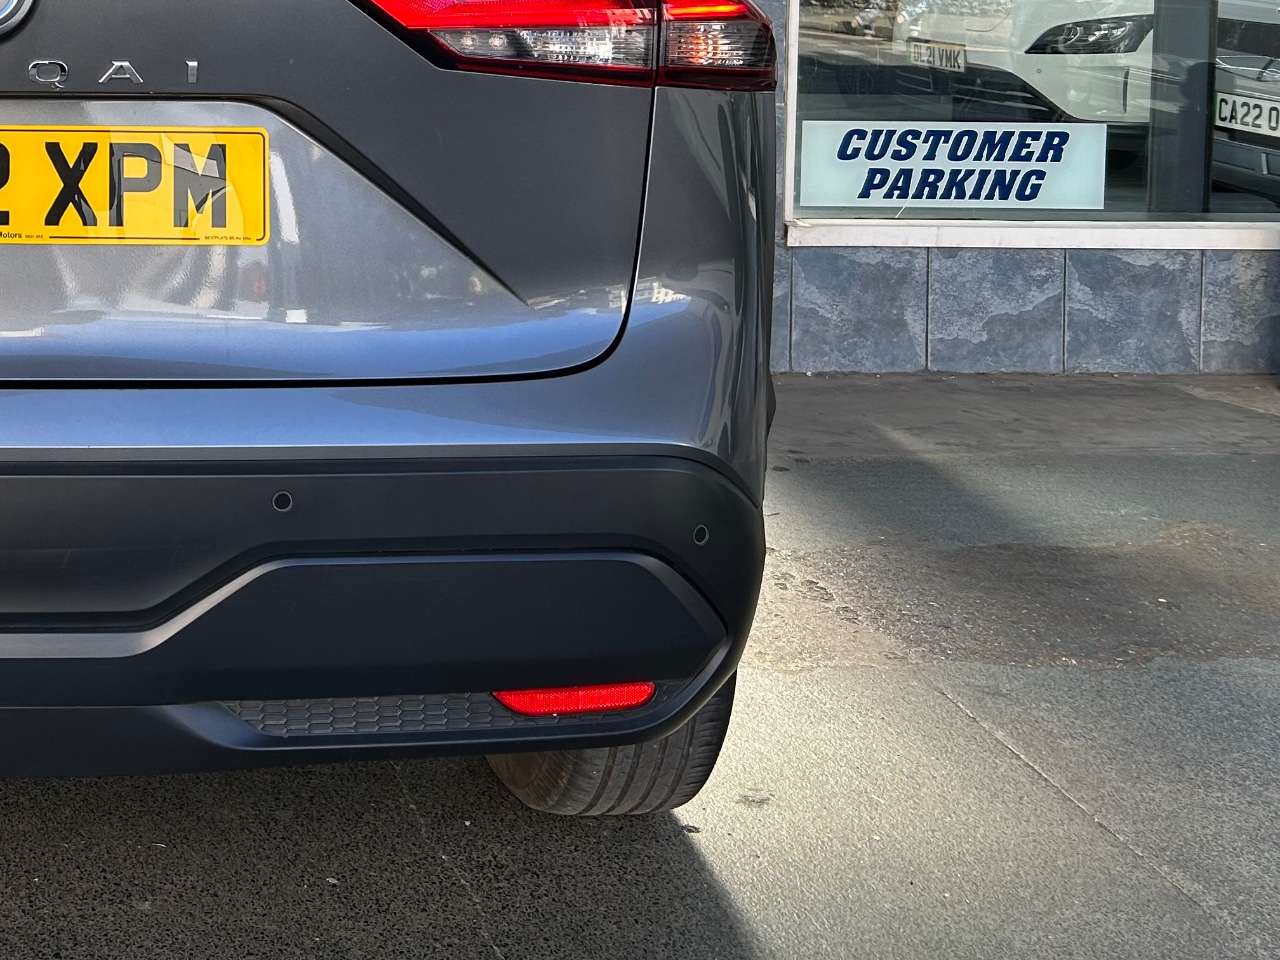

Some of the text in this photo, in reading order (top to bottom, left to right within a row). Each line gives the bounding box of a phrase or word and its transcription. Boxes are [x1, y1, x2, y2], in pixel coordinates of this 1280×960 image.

[1218, 97, 1263, 129] CA22
[836, 128, 1070, 163] CUSTOMER
[43, 141, 227, 228] XPM
[857, 167, 1047, 202] PARKING
